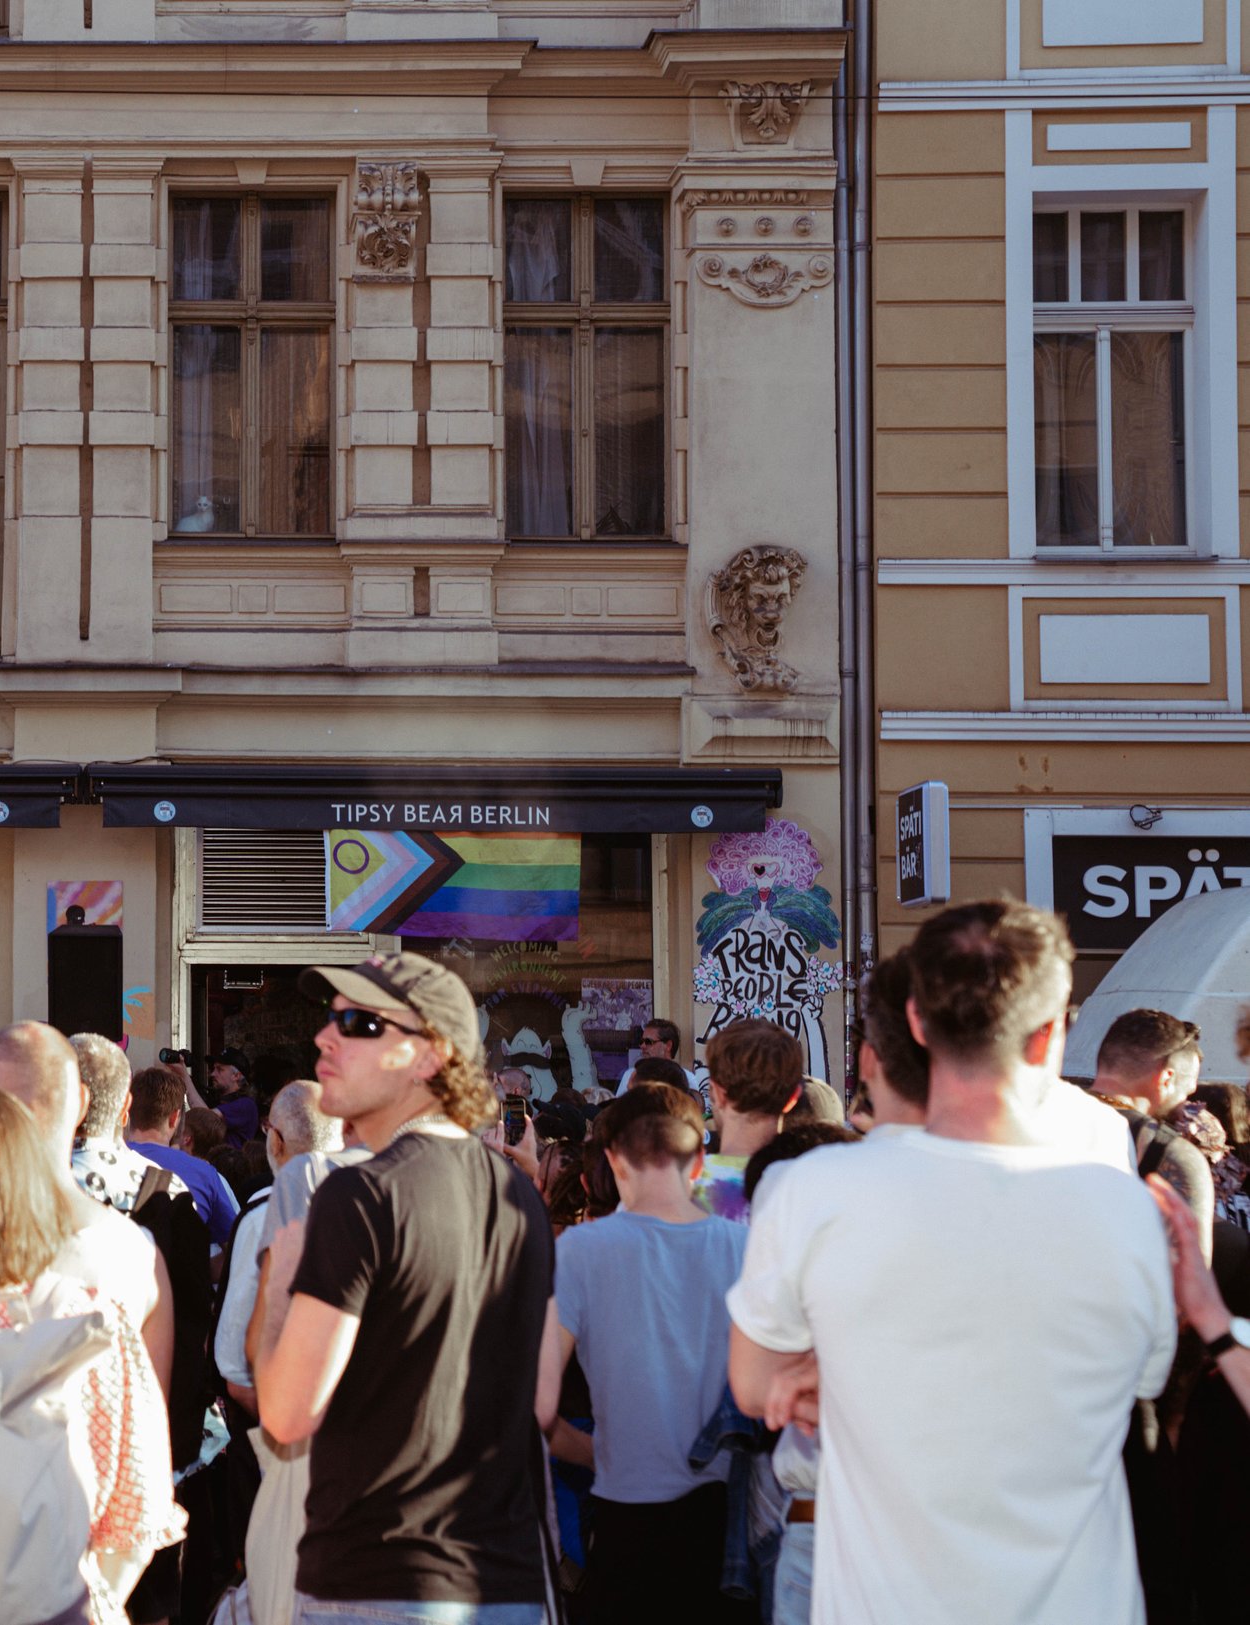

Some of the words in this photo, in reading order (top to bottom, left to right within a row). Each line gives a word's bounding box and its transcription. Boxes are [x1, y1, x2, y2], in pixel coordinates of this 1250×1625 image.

[331, 804, 395, 823] TIPSY
[470, 805, 550, 826] BERLIN
[900, 805, 922, 842] SPÄTI
[901, 846, 917, 880] BÄR
[489, 941, 562, 963] WELCOMING
[486, 960, 567, 986] ENVIRONMENT
[721, 973, 808, 1008] PEOPLE
